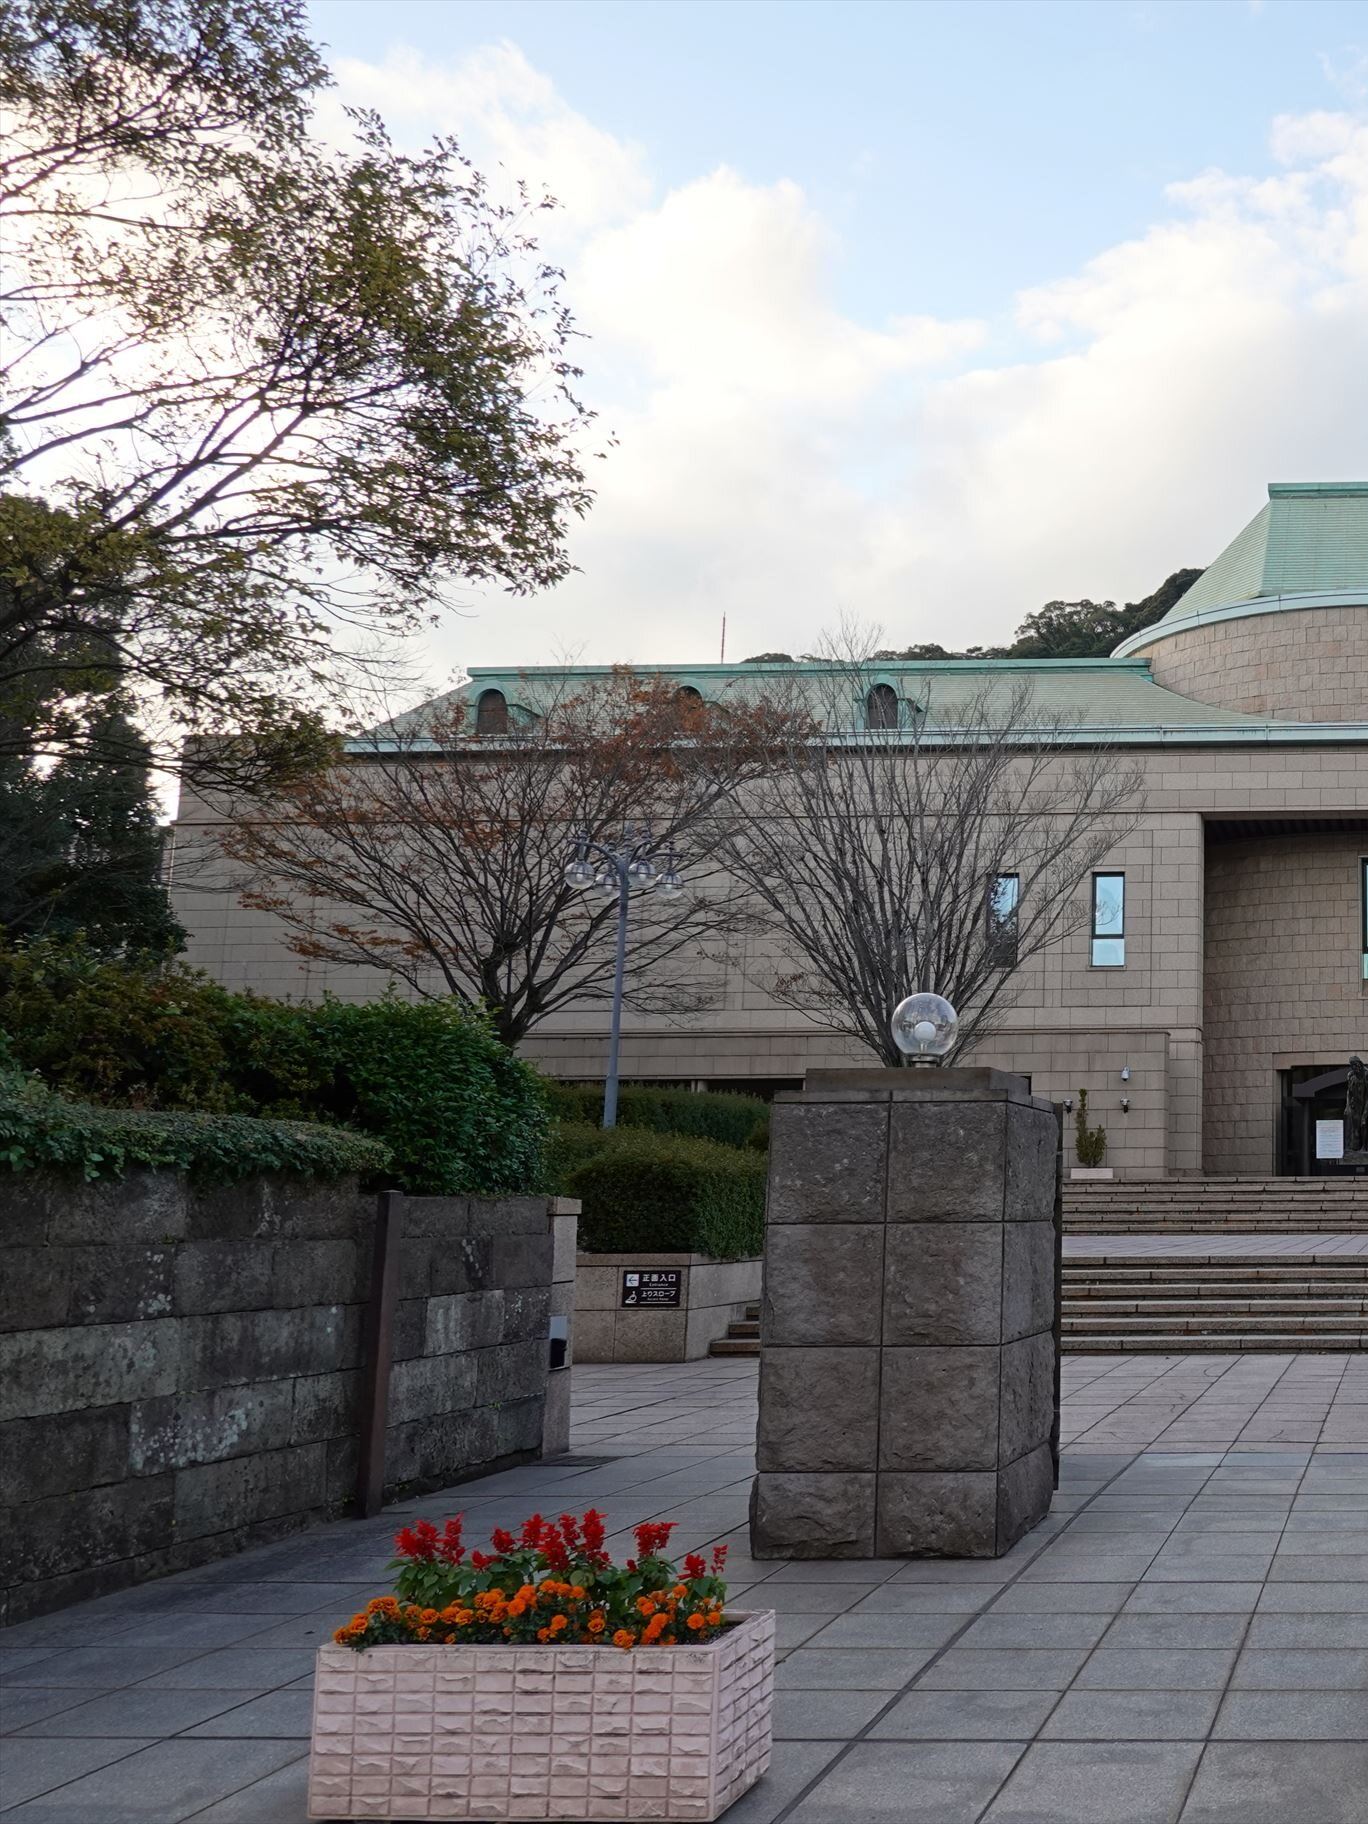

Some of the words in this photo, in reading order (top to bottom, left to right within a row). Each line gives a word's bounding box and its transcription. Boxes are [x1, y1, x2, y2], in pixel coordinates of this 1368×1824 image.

[642, 1274, 676, 1282] 正面入口
[641, 1290, 676, 1298] 上りスロープ
